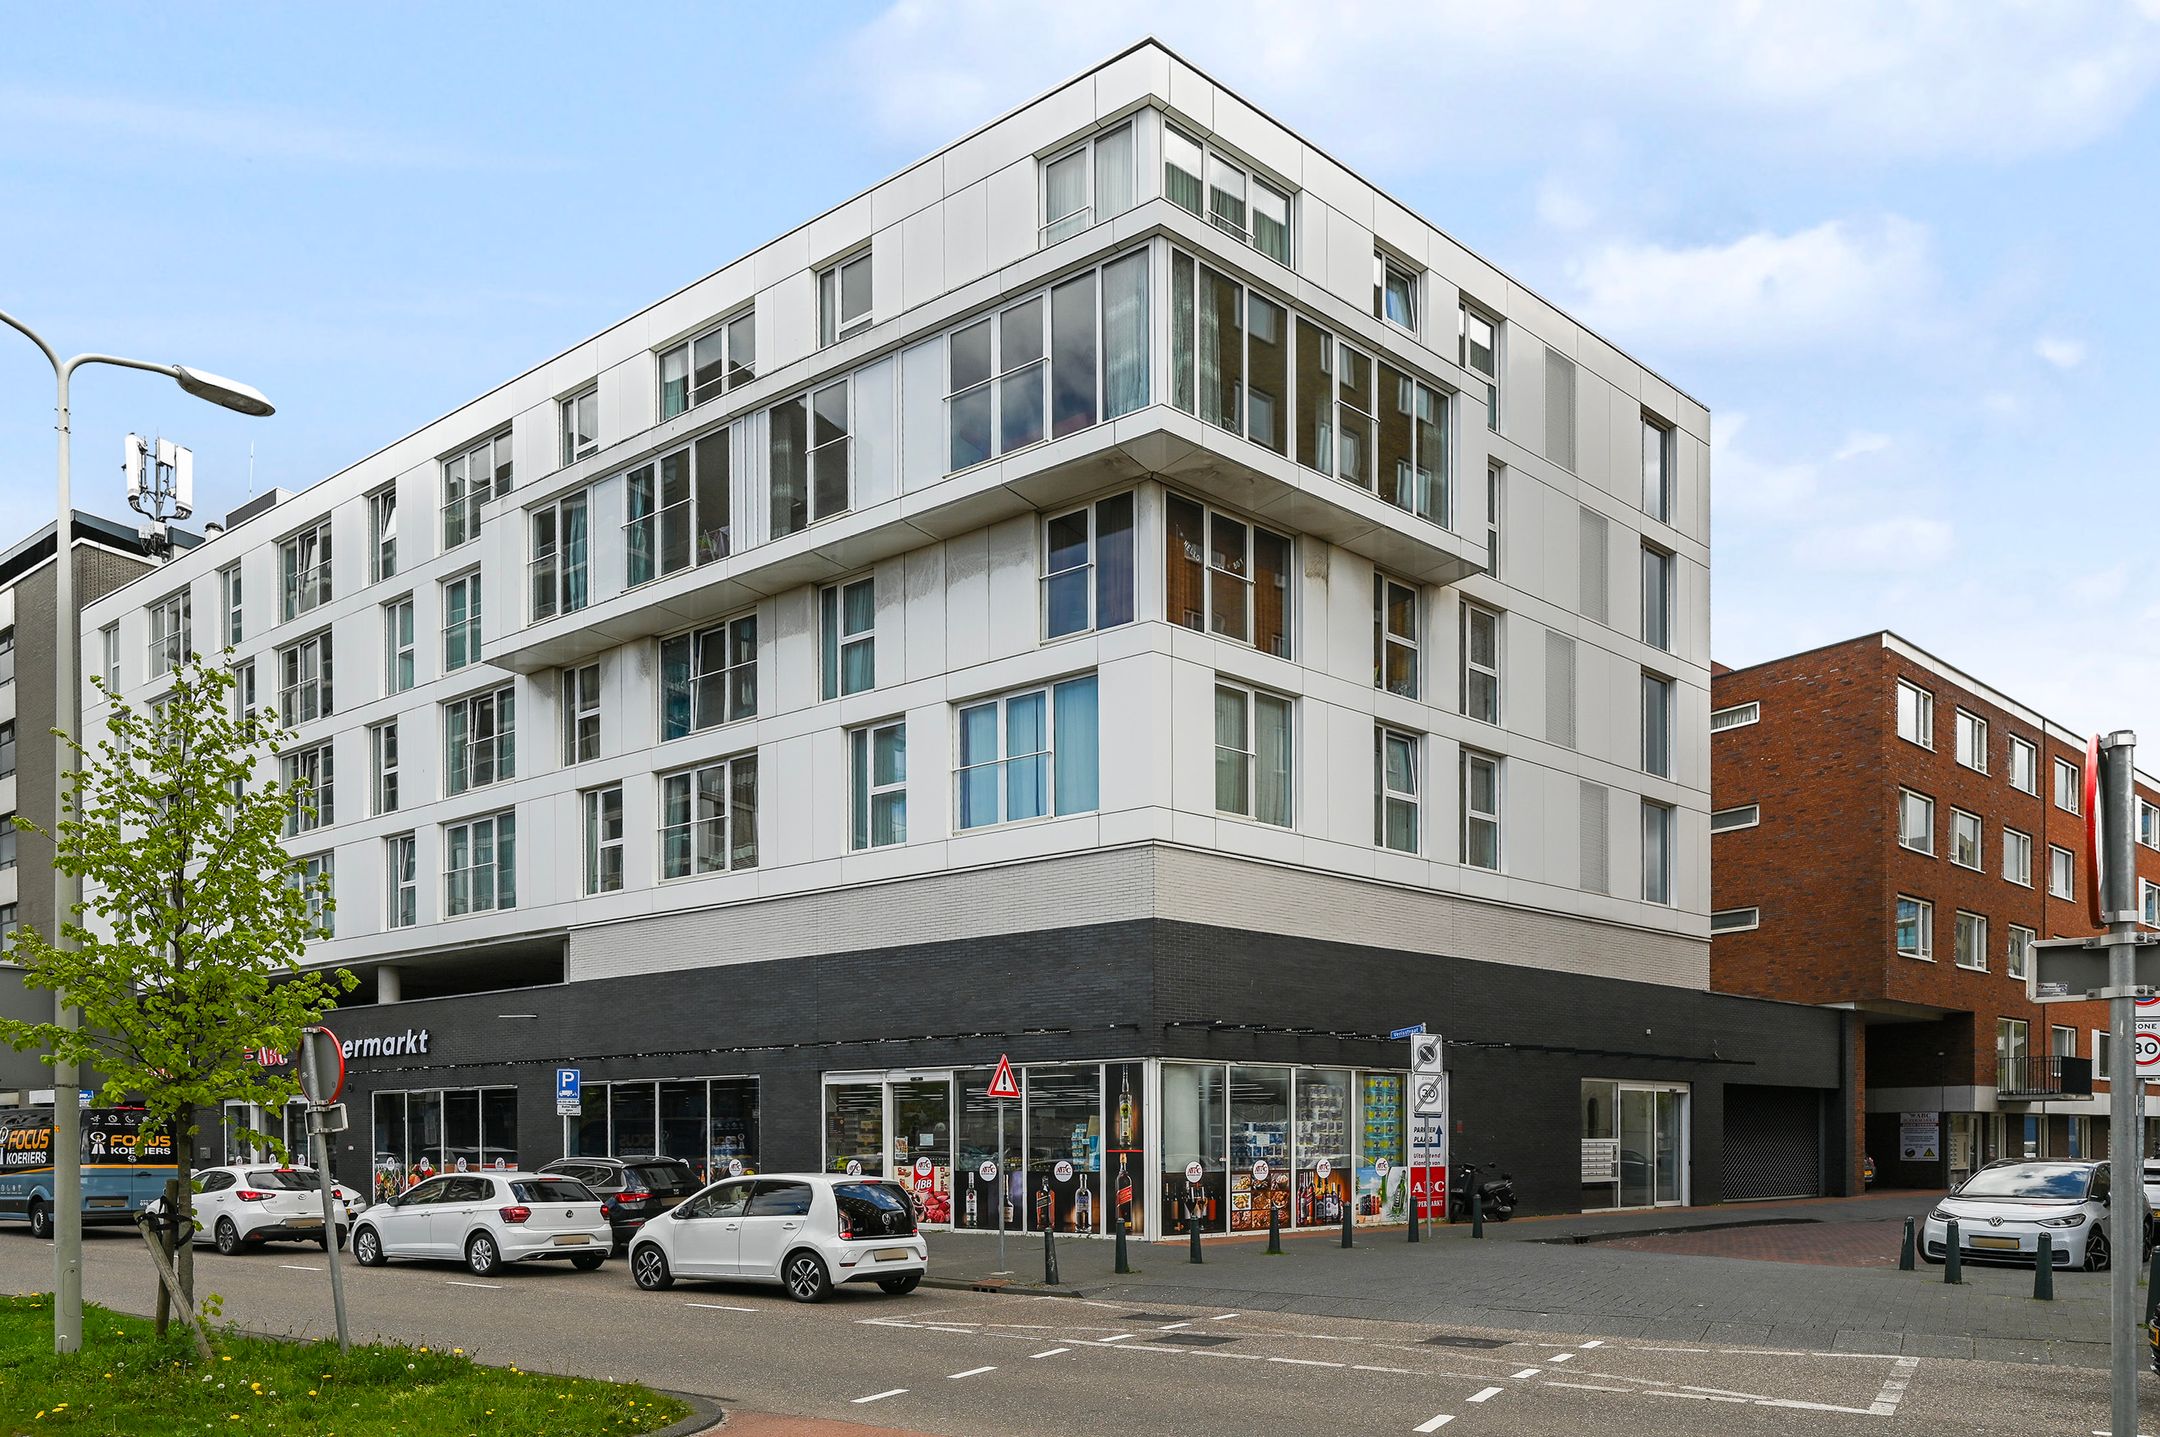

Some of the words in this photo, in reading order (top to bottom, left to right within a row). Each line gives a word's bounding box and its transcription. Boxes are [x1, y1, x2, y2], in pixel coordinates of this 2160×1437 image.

[1184, 540, 1200, 561] HELLO
[342, 1029, 429, 1059] ermarkt
[562, 1071, 575, 1088] P
[8, 1128, 51, 1150] FOCUS
[6, 1151, 48, 1165] KOERIERS
[110, 1147, 171, 1155] KOEIERS
